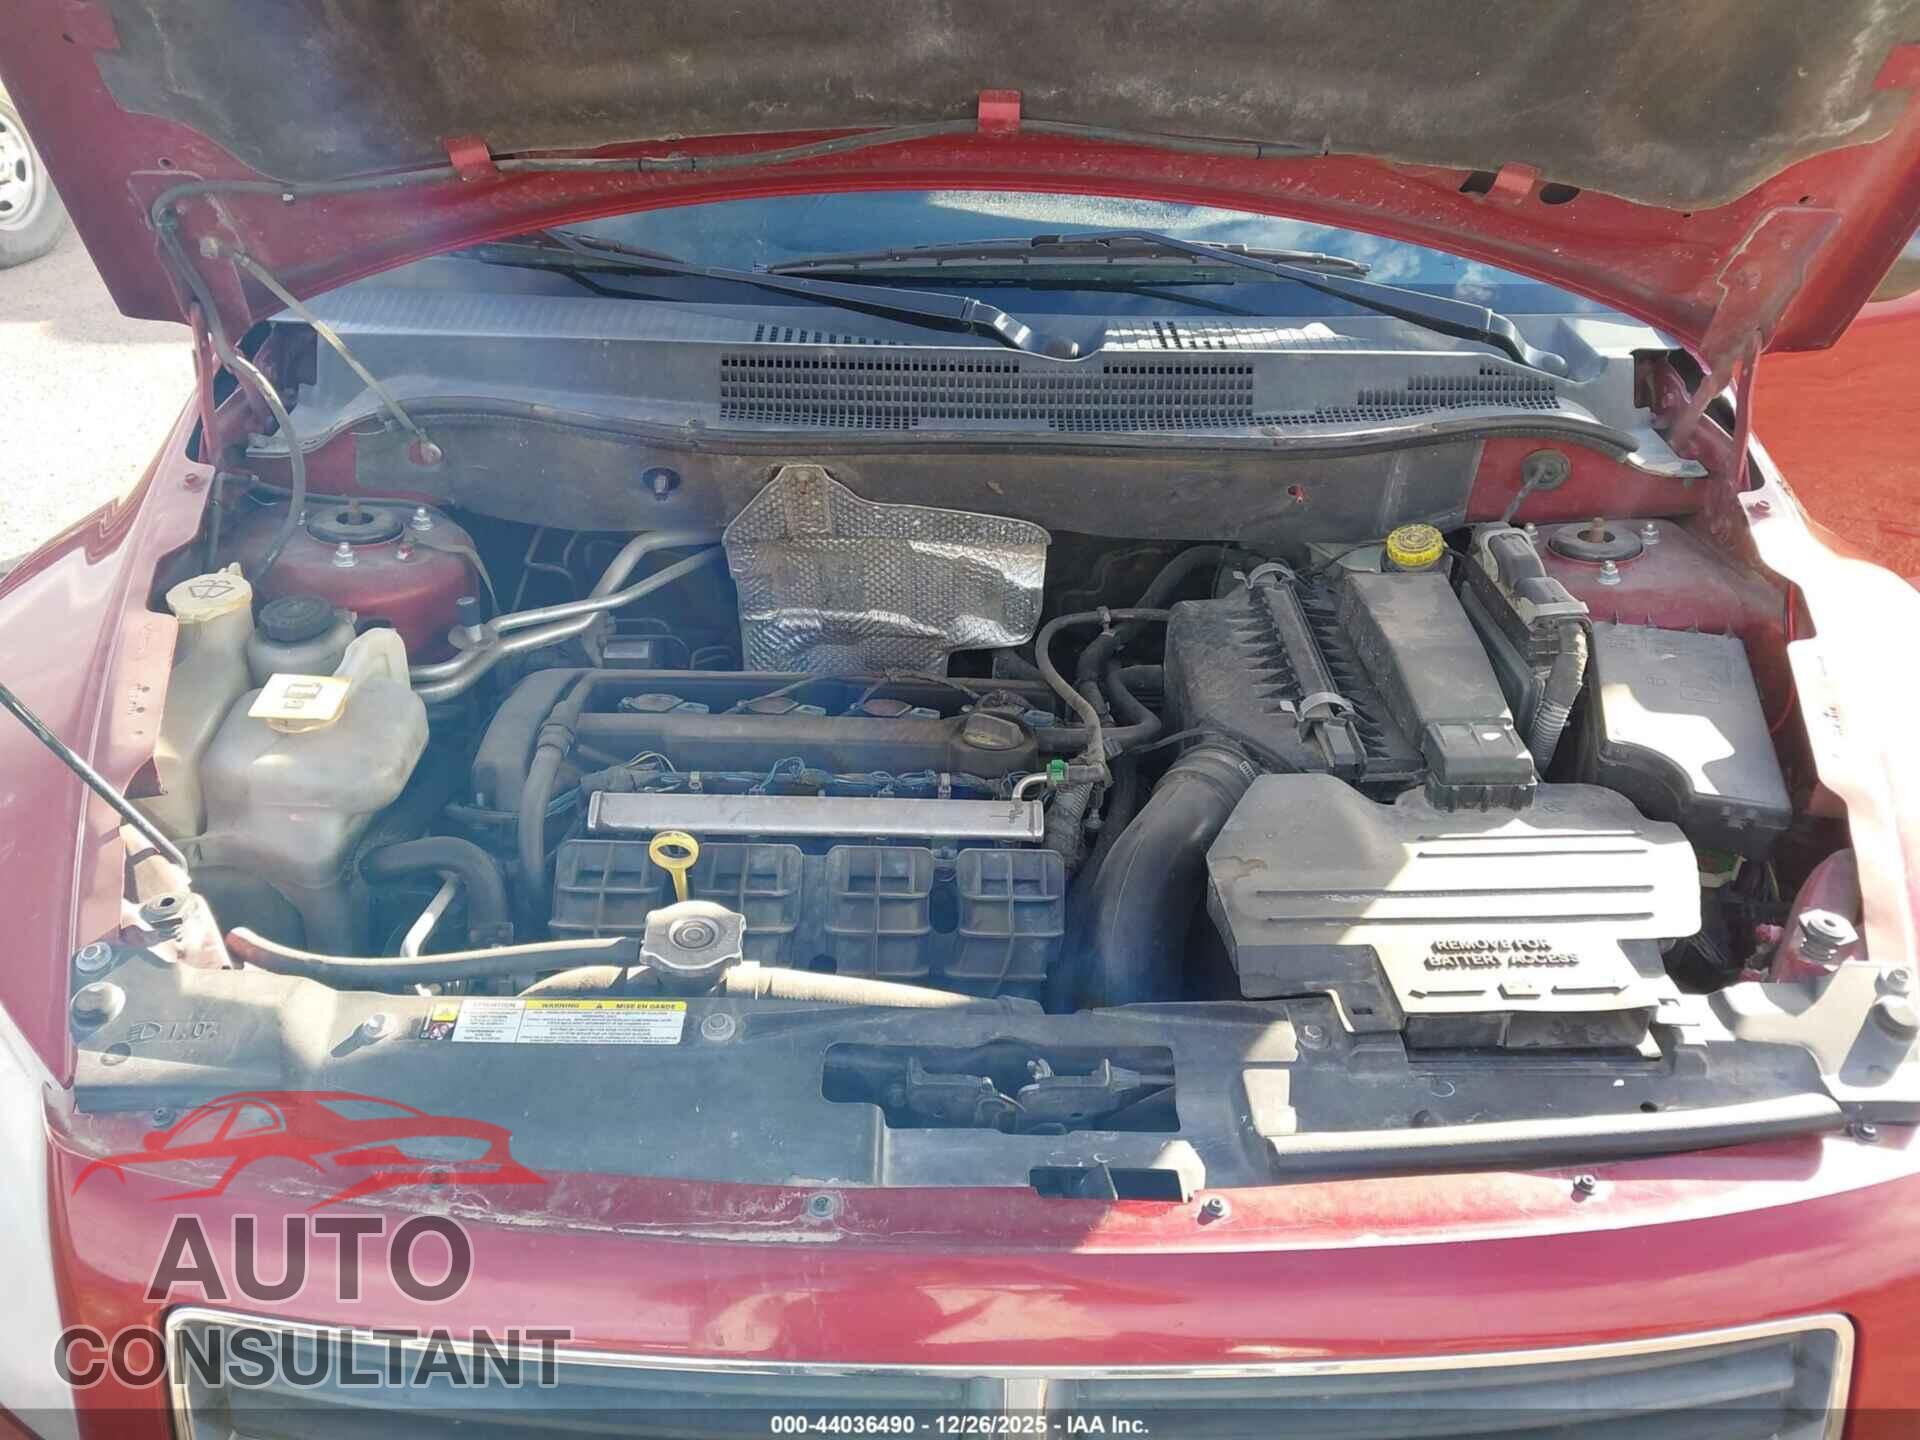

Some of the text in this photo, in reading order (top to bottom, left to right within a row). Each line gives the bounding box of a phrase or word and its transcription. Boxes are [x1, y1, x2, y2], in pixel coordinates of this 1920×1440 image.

[1431, 938, 1552, 954] REMOVE FOR
[1508, 952, 1579, 968] ACCESS
